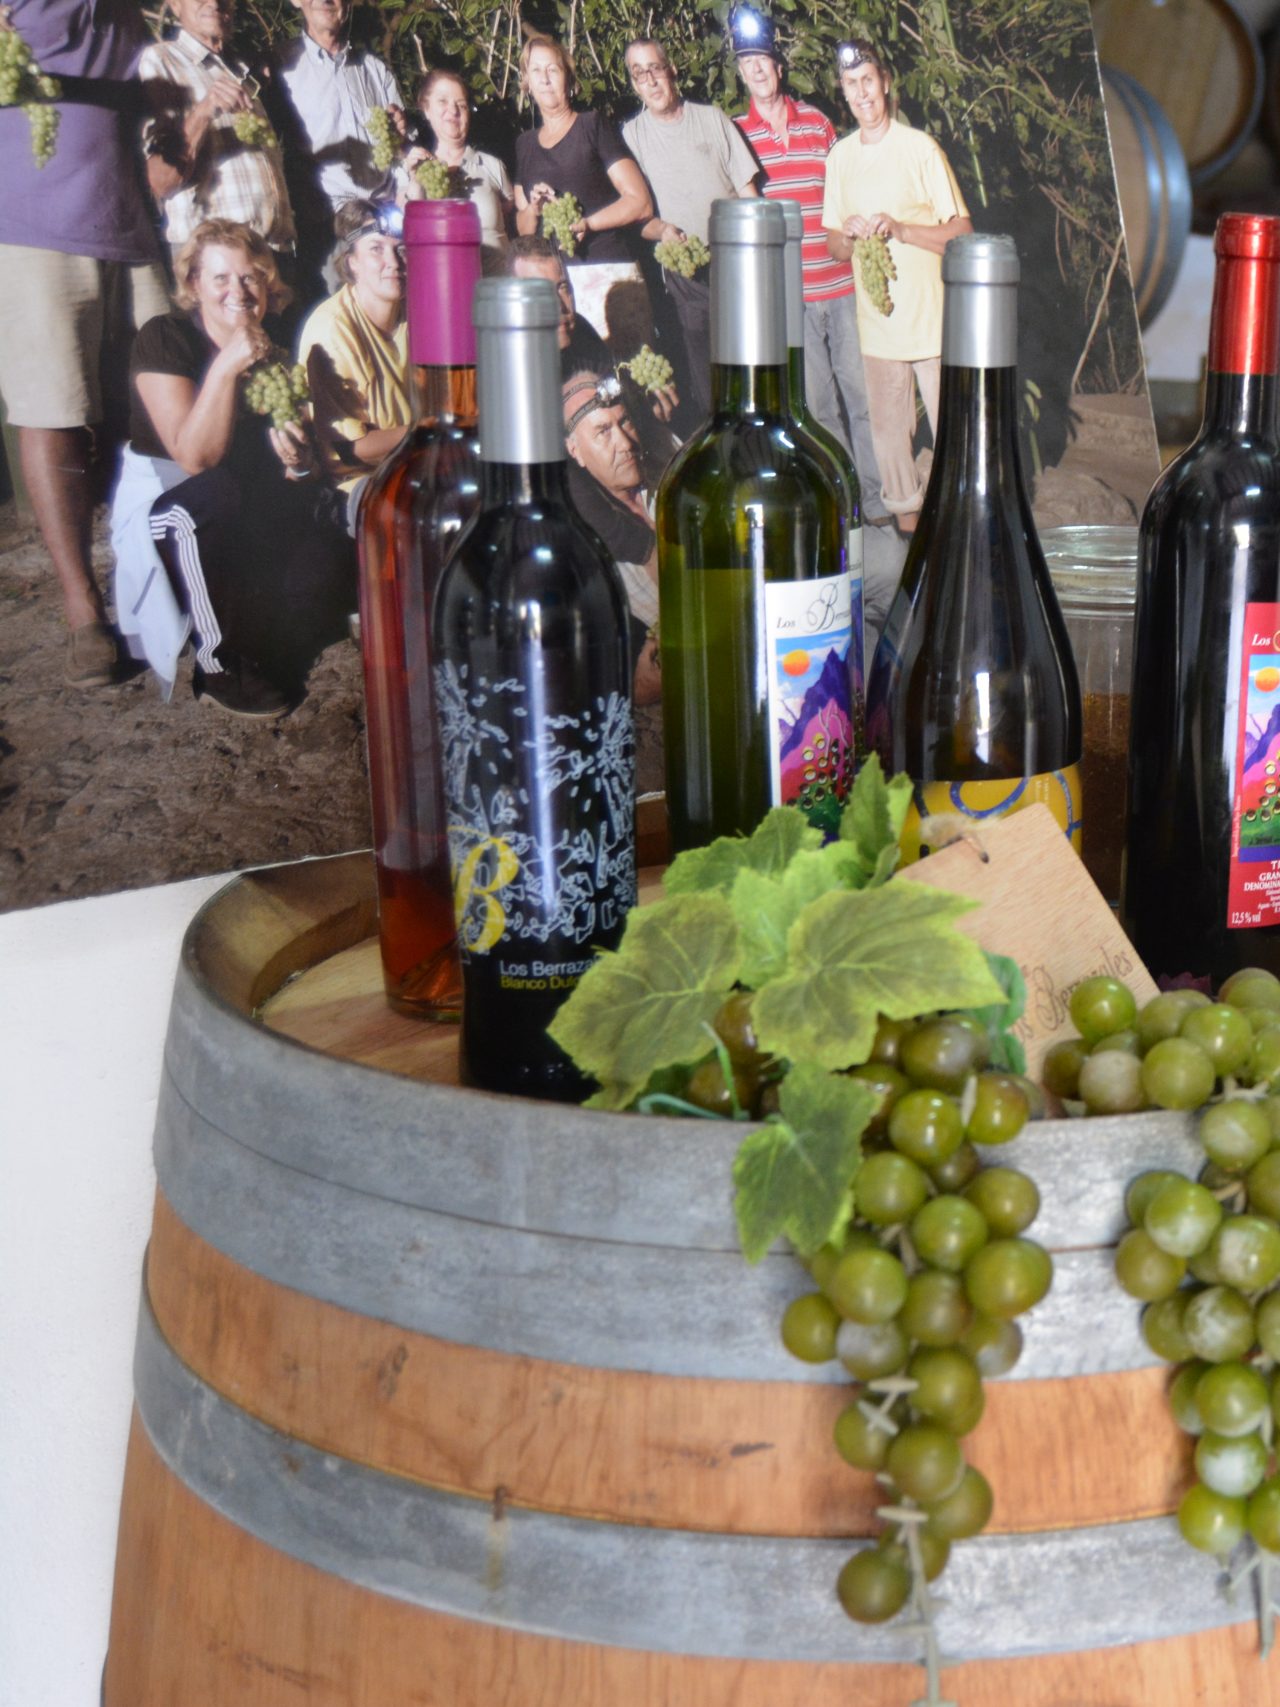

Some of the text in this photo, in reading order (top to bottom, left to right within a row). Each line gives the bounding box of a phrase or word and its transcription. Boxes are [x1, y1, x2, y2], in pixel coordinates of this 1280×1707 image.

[776, 616, 796, 628] Los
[1251, 633, 1271, 646] Los
[500, 956, 598, 976] Los Berraza
[501, 976, 547, 990] Blanco
